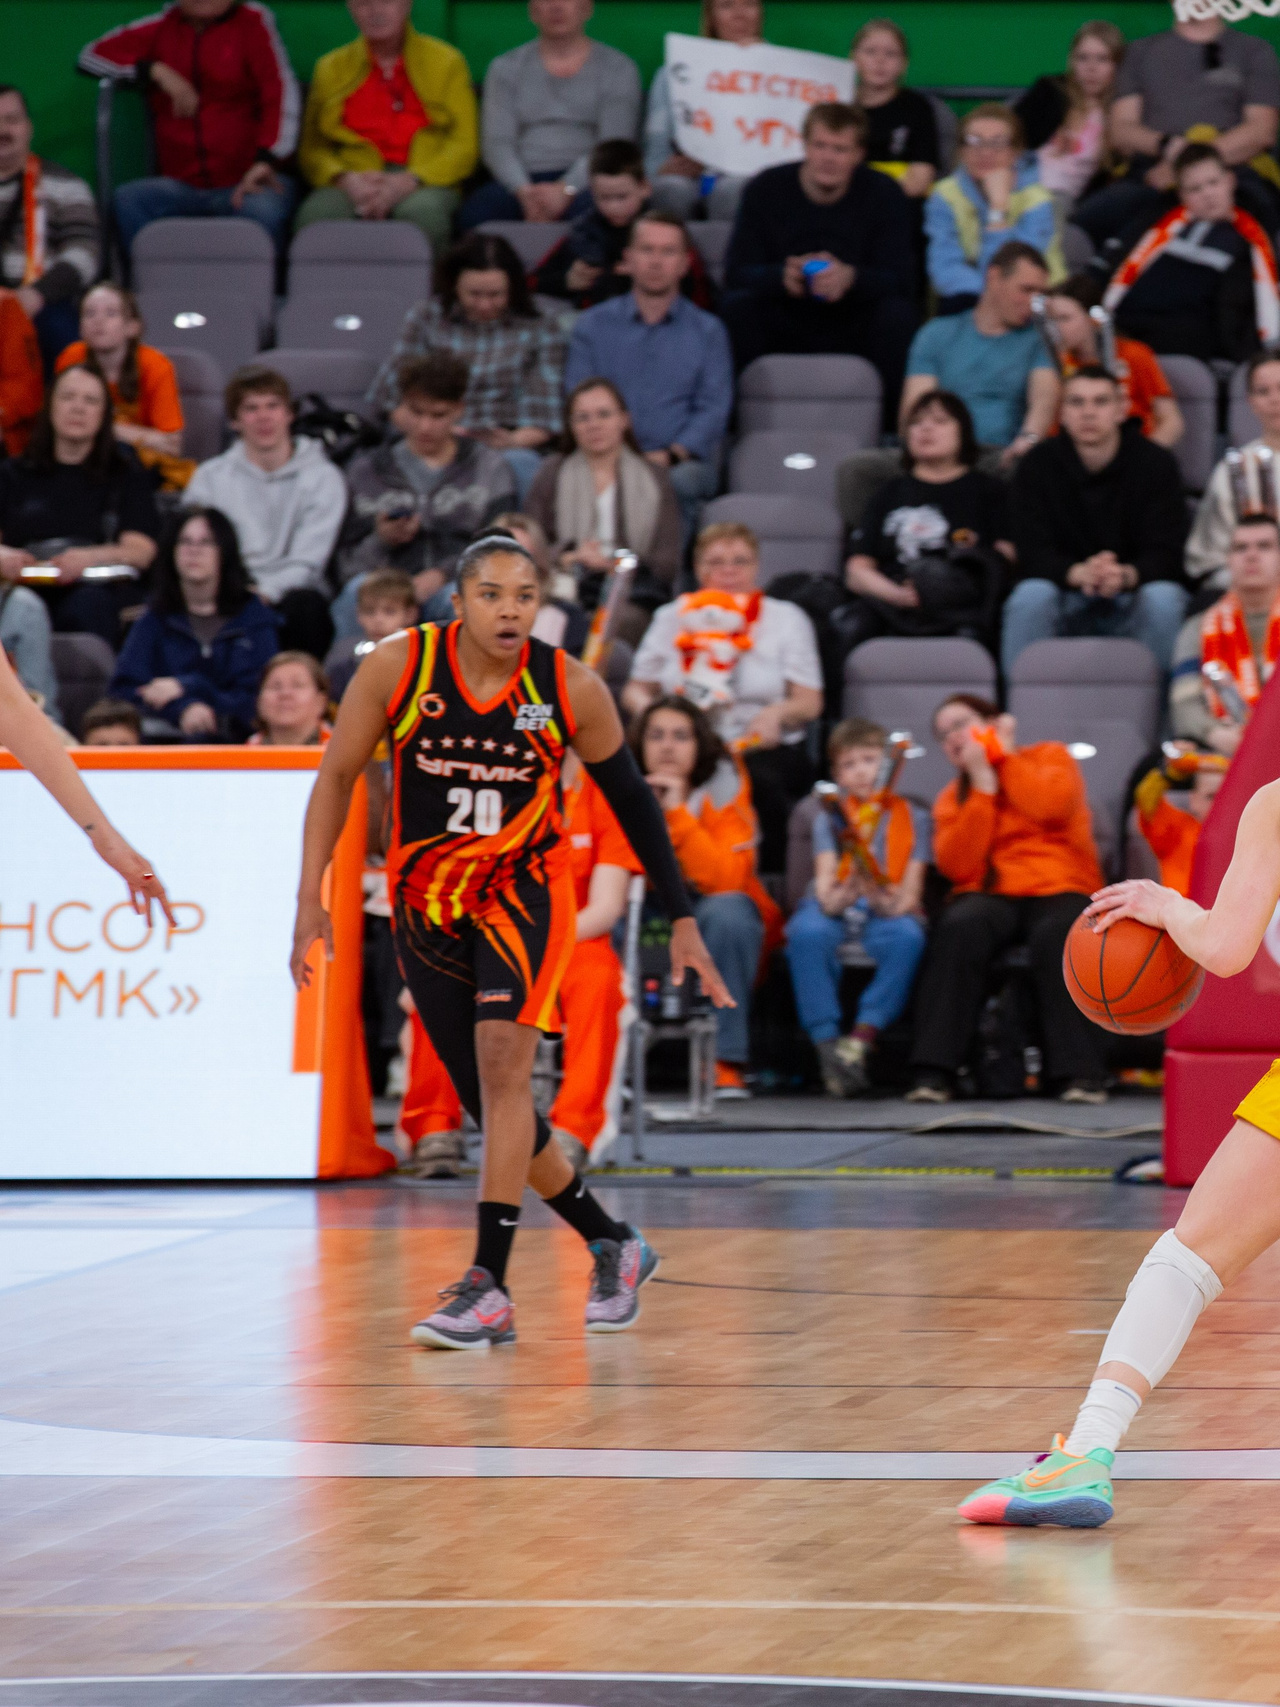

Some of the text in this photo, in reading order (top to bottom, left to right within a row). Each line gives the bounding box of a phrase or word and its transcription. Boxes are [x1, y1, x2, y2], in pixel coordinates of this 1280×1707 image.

[513, 717, 550, 731] BET
[517, 704, 554, 718] FON
[415, 753, 537, 782] УГМК
[446, 787, 502, 836] 20
[0, 968, 202, 1018] ГМК»
